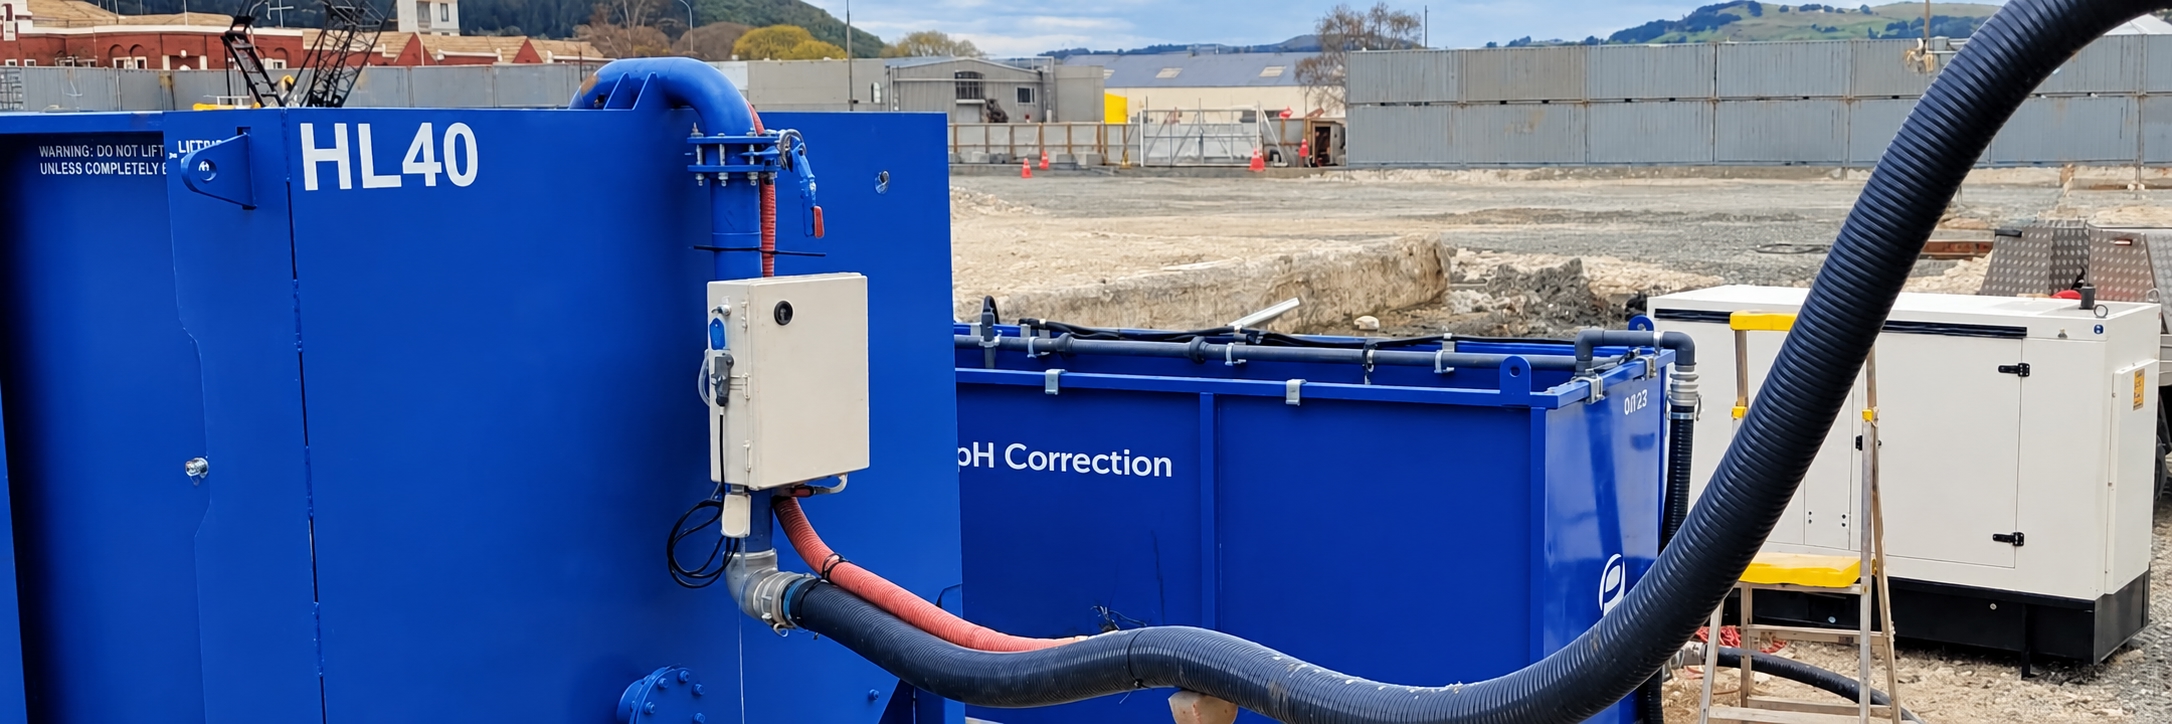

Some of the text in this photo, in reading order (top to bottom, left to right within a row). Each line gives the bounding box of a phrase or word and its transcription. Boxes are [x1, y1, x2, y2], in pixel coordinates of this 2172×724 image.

[39, 144, 165, 158] WARNING: DO NOT LIFT
[300, 122, 478, 191] HL40
[40, 161, 83, 175] UNLESS
[85, 161, 159, 175] COMPLETELY
[957, 441, 1172, 477] pH Correction
